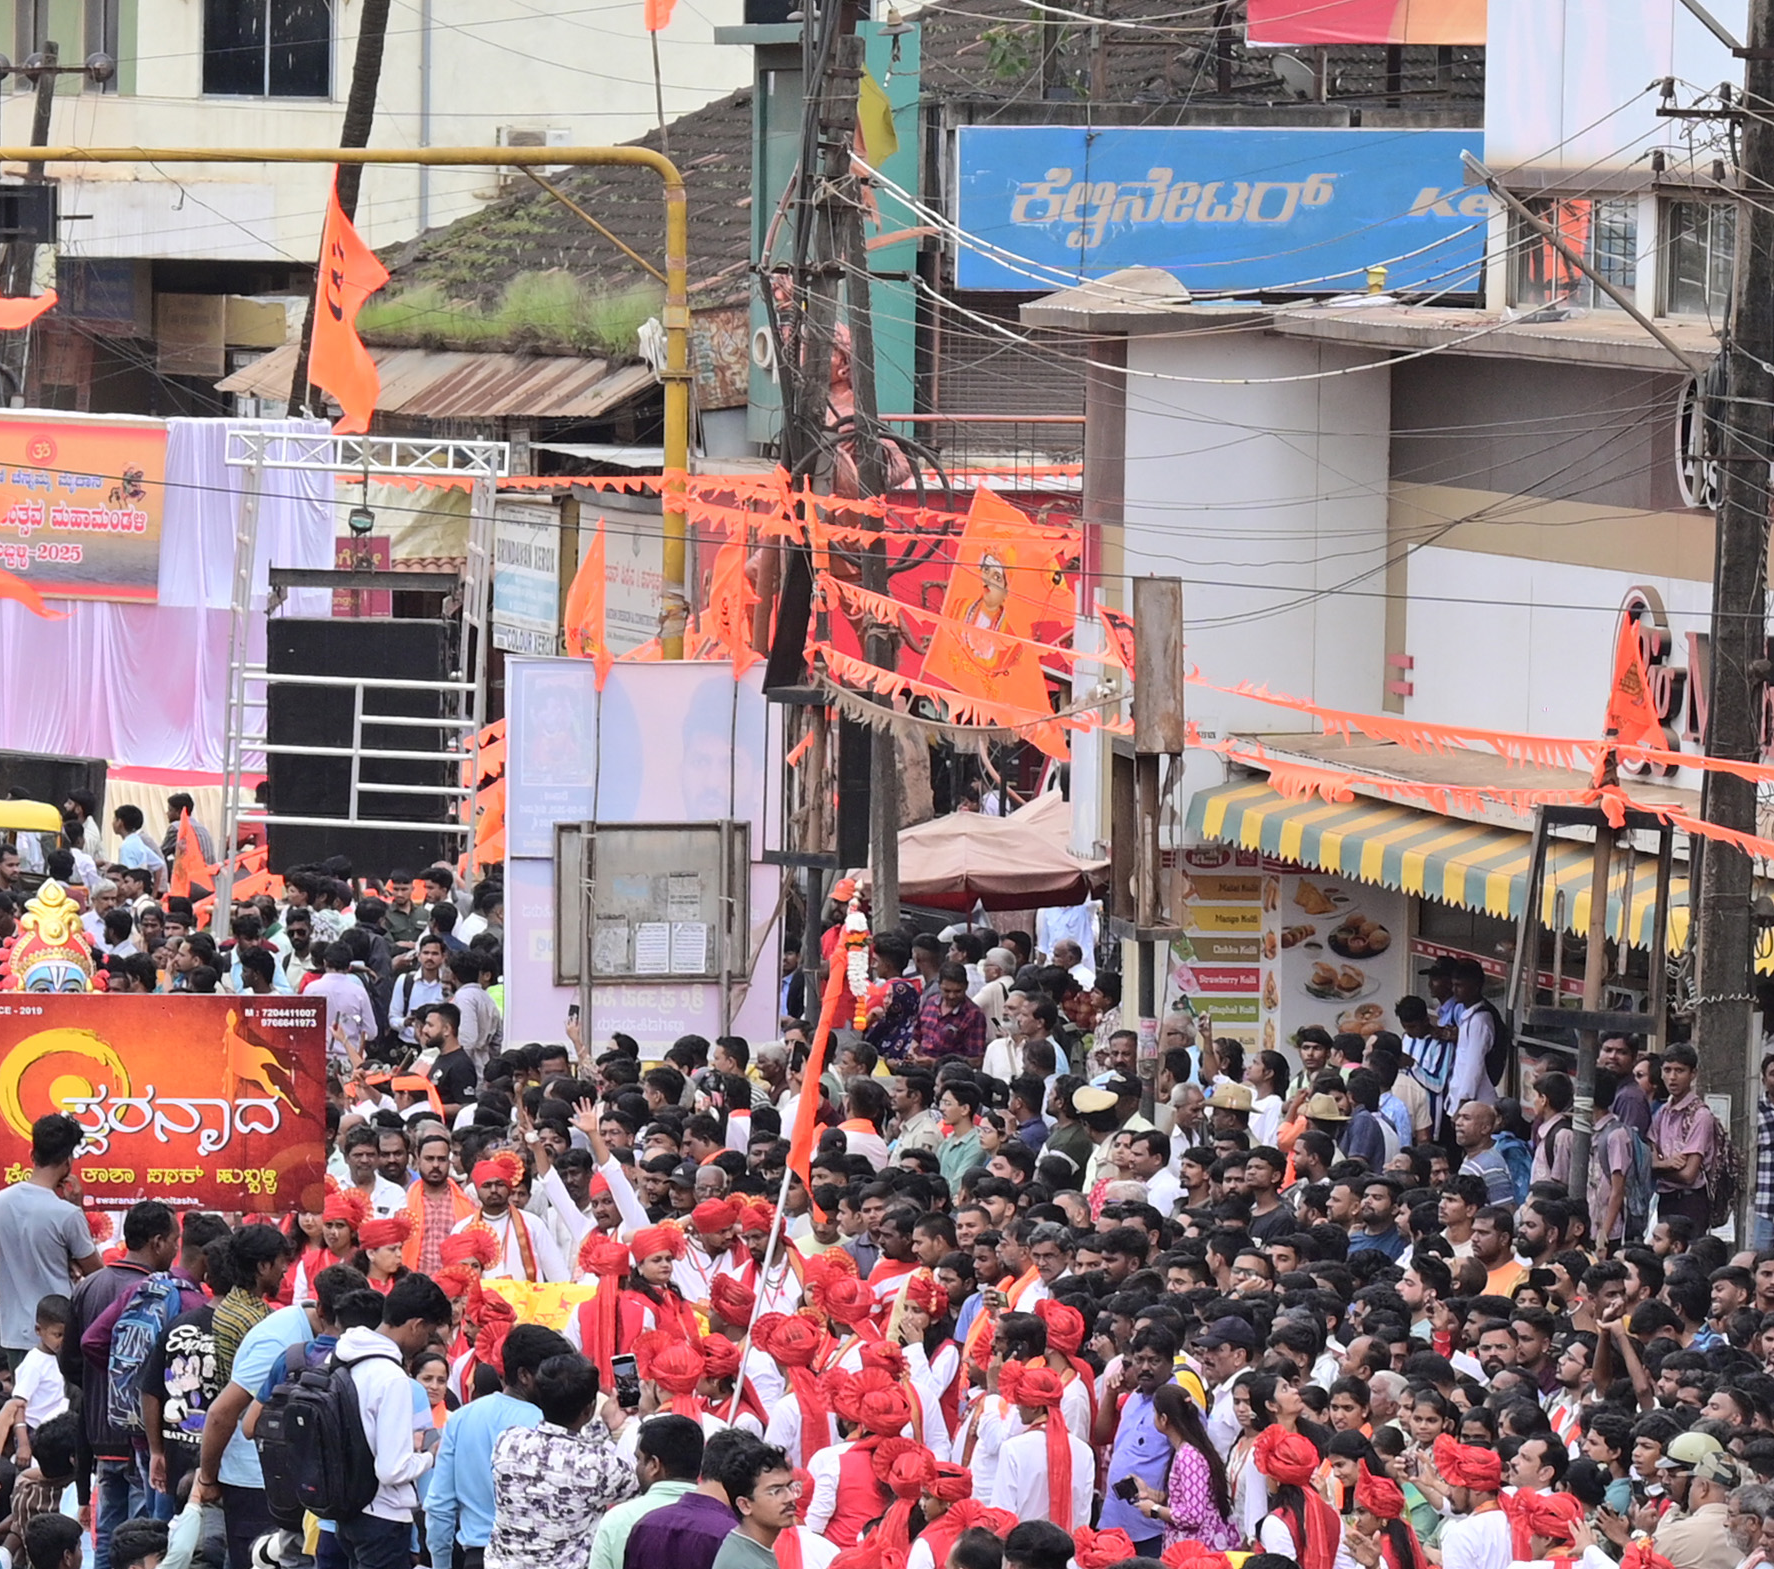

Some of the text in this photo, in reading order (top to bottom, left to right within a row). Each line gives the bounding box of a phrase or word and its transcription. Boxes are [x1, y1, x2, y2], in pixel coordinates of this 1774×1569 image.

[1240, 884, 1259, 893] Kulfi
[1214, 914, 1258, 925] Mango Kulfi
[1239, 944, 1258, 955] Kulfi
[1198, 974, 1258, 985] Strawberry Kulfi
[20, 1006, 43, 1015] 2019
[262, 1008, 317, 1018] 7204411007
[1239, 1005, 1257, 1015] Kulfi
